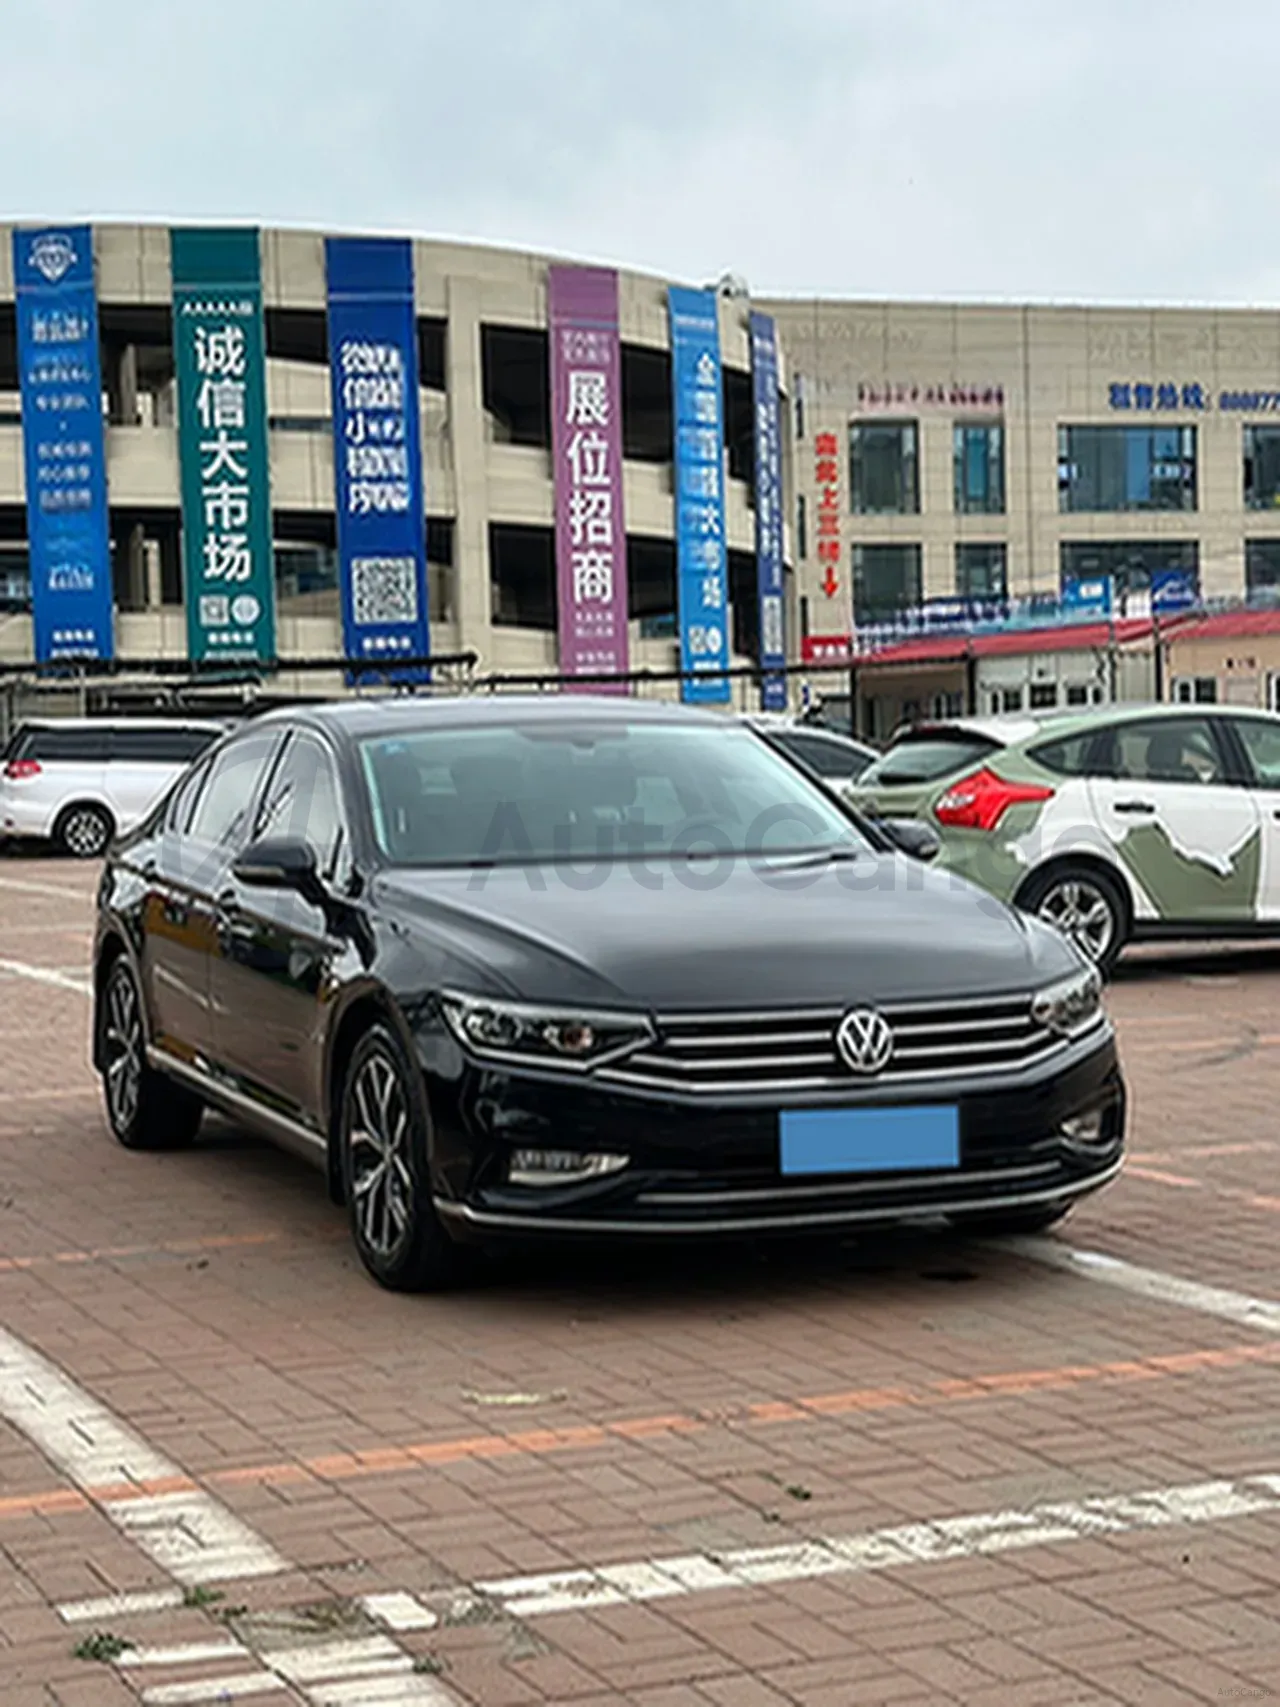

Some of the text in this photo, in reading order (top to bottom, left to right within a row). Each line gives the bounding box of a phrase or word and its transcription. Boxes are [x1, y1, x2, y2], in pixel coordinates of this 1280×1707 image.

[194, 326, 252, 583] 诚信大市场
[566, 370, 614, 605] 展位招商
[837, 1009, 893, 1073] VW
